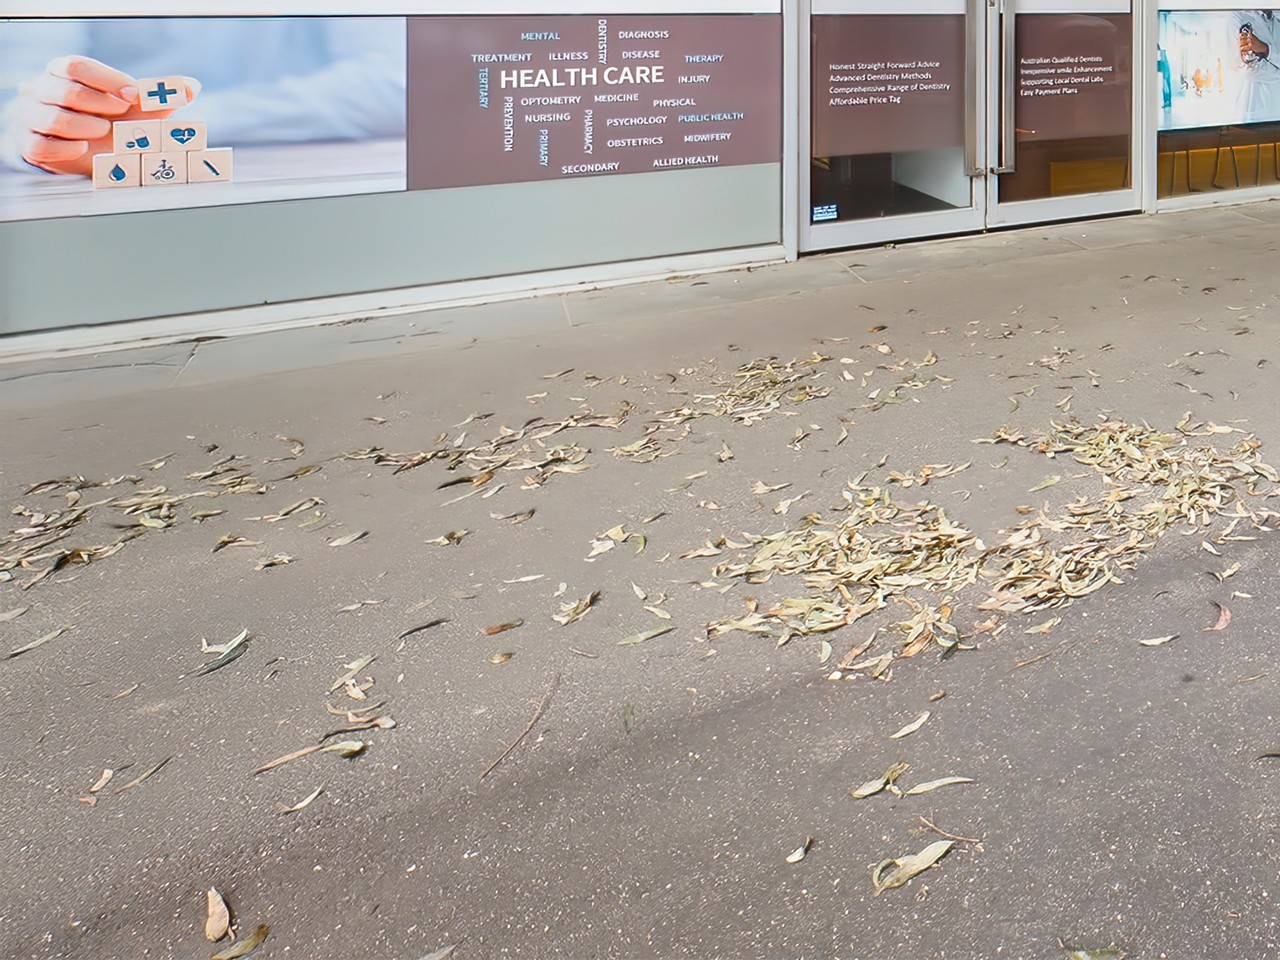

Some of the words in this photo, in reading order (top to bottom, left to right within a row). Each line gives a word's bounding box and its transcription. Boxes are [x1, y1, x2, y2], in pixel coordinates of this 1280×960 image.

[521, 31, 560, 40] MENTAL
[619, 30, 669, 39] DIAGNOSIS
[598, 19, 607, 65] DENTISTRY
[472, 53, 532, 63] TREATMENT
[549, 52, 589, 61] ILLNESS
[622, 50, 660, 59] DISEASE
[684, 54, 724, 63] THERAPY
[500, 68, 598, 89] HEALTH
[603, 66, 665, 85] CARE
[678, 75, 711, 84] INJURY
[479, 68, 489, 108] TERTIARY
[521, 96, 582, 106] OPTOMETRY
[594, 93, 639, 103] MEDICINE
[653, 98, 696, 107] PHYSICAL
[525, 113, 571, 123] NURSING
[607, 115, 668, 127] PSYCHOLOGY
[678, 114, 709, 123] PUBLIC
[710, 112, 744, 121] HEALTH
[504, 97, 513, 152] PREVENTION
[584, 109, 593, 154] PHARMACY
[607, 137, 664, 147] OBSTETRICS
[684, 133, 731, 143] MIDWIFERY
[539, 129, 548, 167] PRIMARY
[653, 158, 683, 167] ALLIED
[684, 155, 719, 165] HEALTH
[562, 162, 620, 174] SECONDARY
